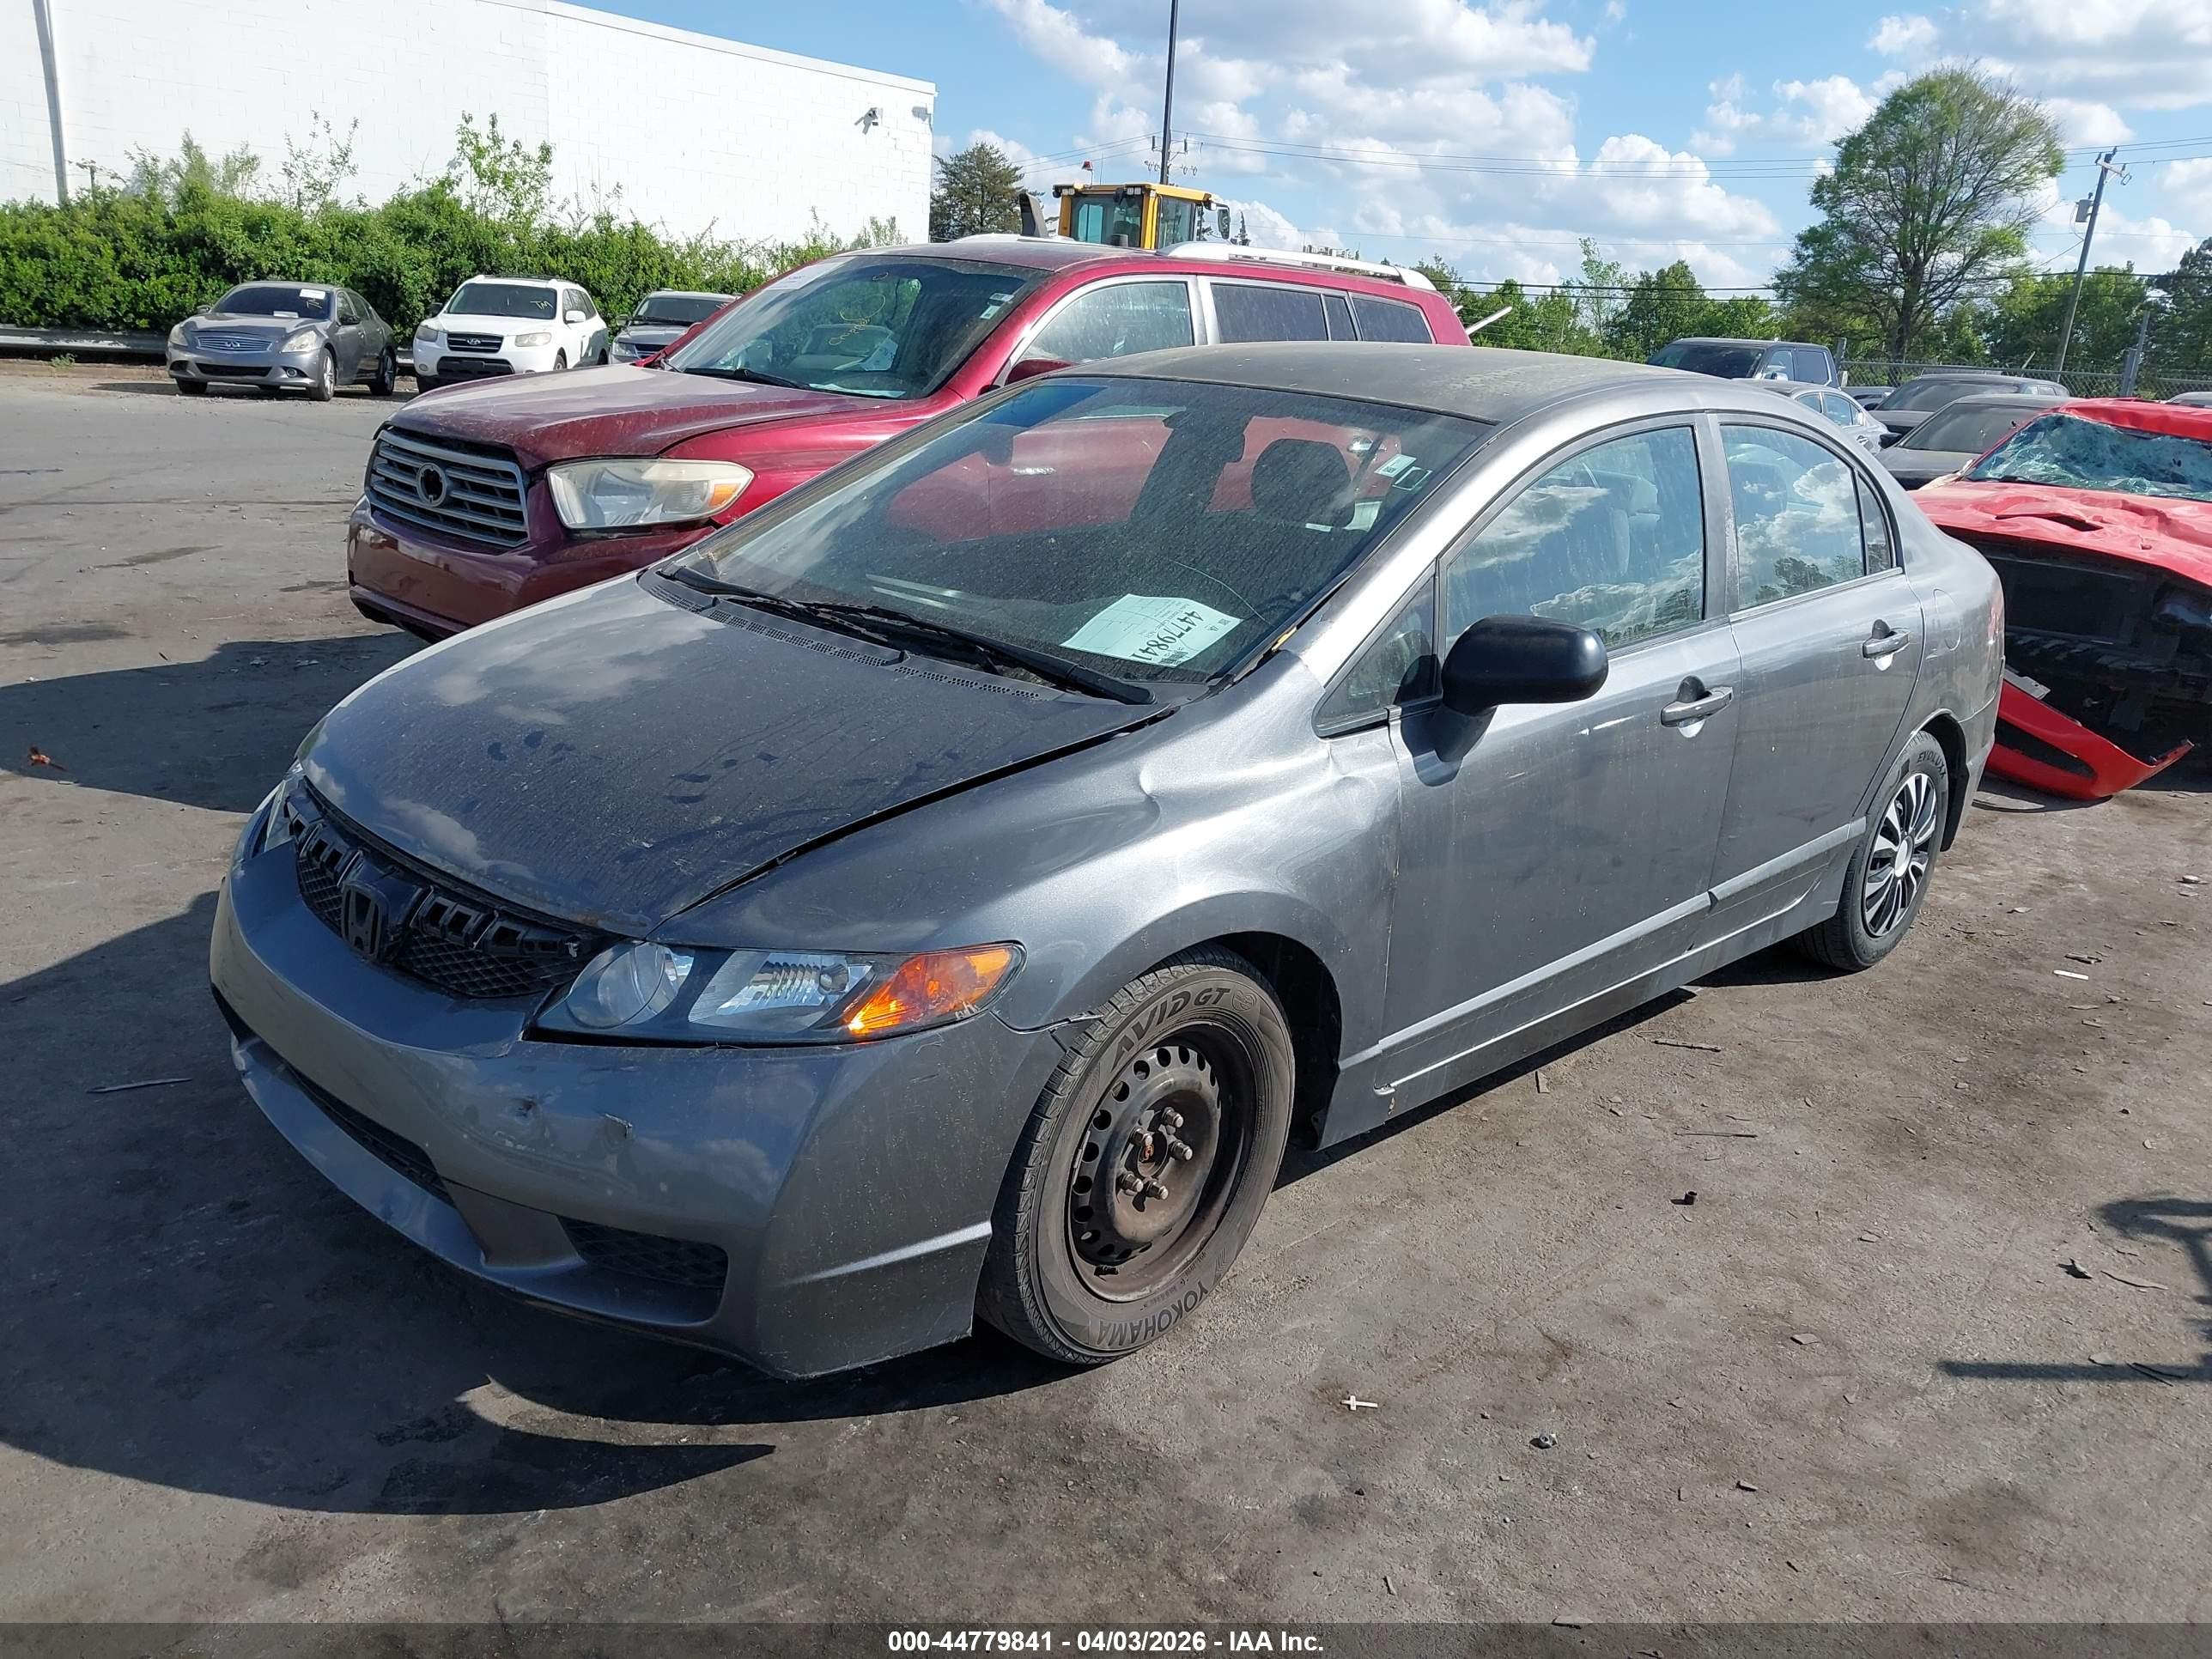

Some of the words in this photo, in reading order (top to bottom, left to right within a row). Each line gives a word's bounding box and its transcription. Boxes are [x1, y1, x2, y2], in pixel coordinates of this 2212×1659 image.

[1128, 611, 1205, 661] 44779841
[1110, 990, 1192, 1073] AVID
[1194, 988, 1231, 1006] GT
[1097, 1279, 1209, 1347] YOKOHAMA
